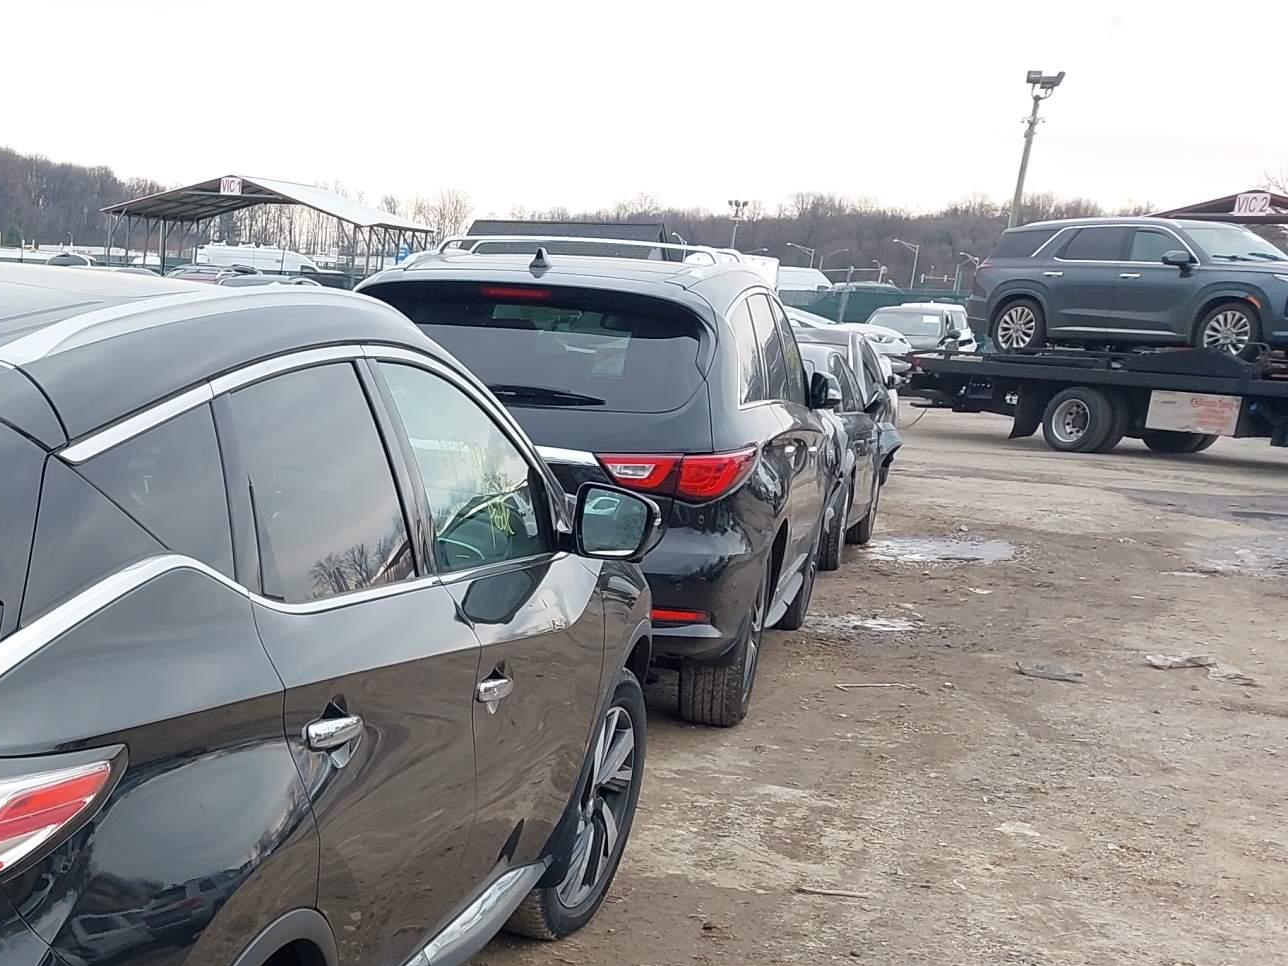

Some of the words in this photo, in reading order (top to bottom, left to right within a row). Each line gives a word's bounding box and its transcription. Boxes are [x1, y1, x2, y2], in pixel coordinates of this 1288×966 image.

[222, 179, 235, 192] VIC
[1238, 197, 1257, 213] VIC
[1259, 196, 1269, 212] 2
